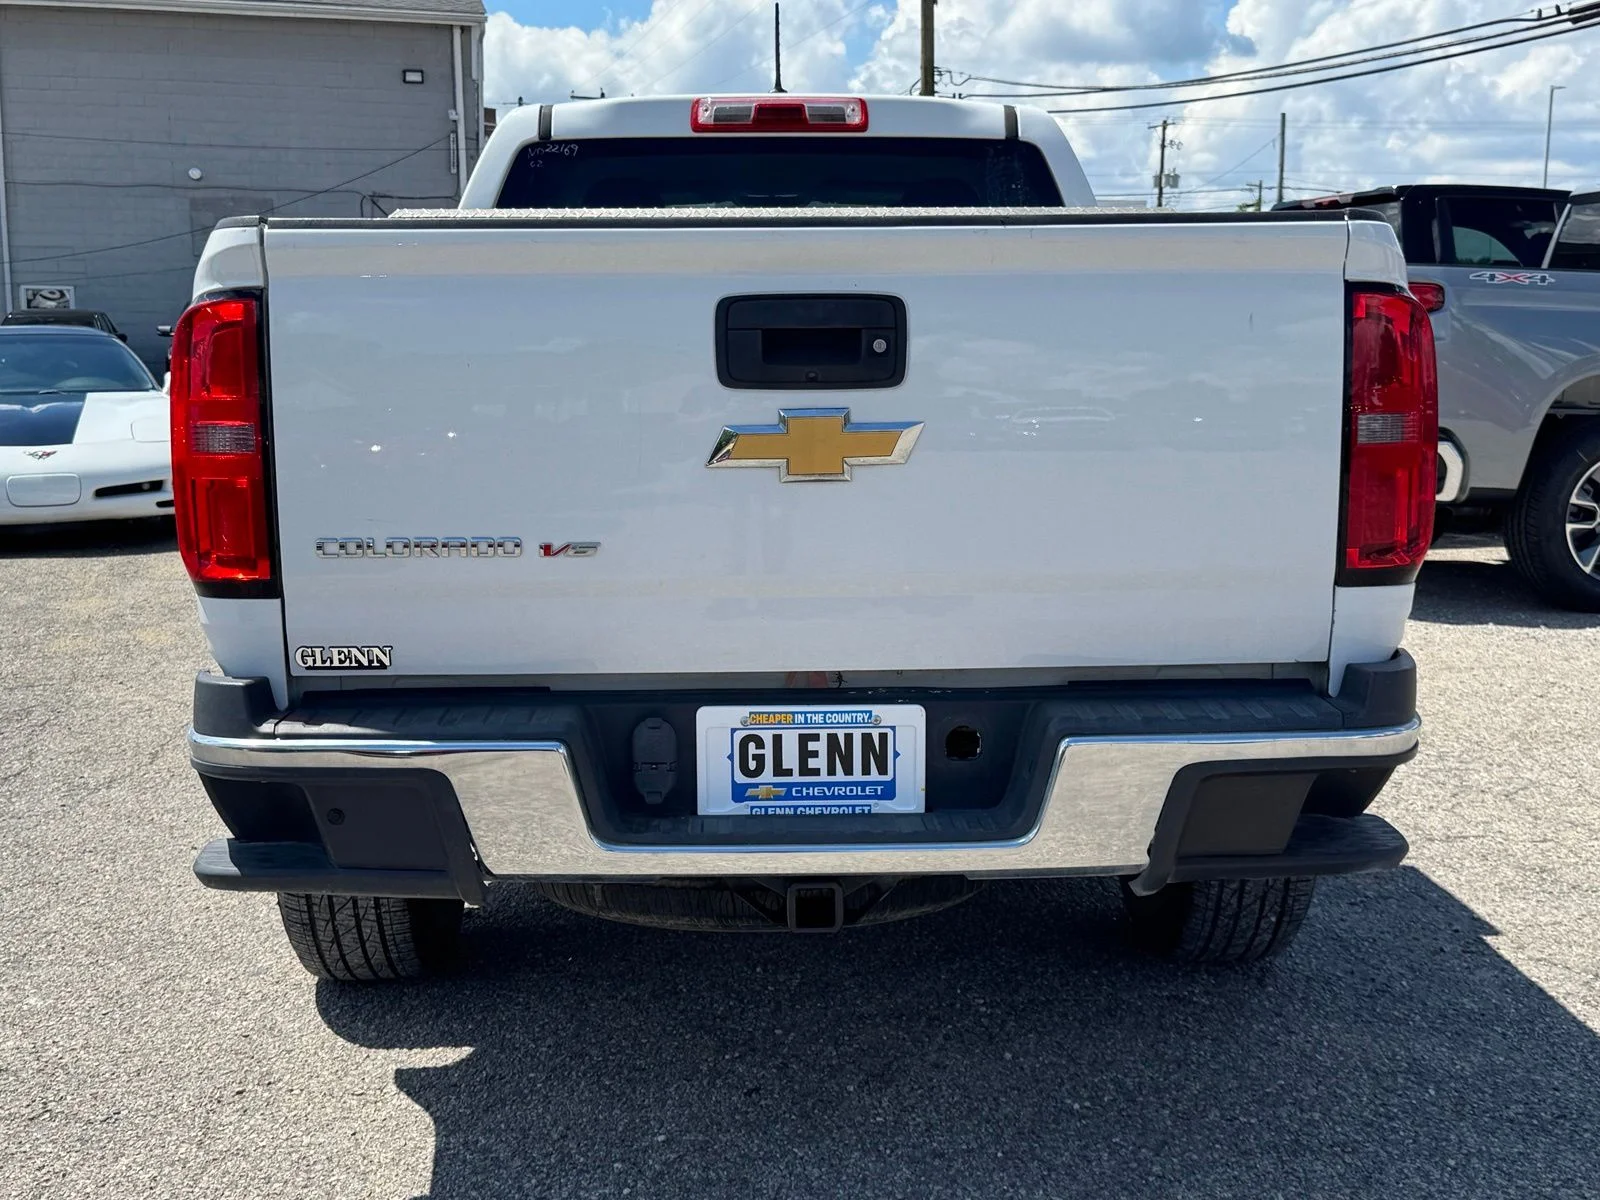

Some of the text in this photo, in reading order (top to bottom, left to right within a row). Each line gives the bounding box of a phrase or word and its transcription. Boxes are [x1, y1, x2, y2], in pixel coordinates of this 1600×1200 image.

[316, 536, 523, 559] COLORADO
[294, 645, 393, 669] GLENN
[749, 712, 872, 725] CHEAPER IN THE COUNTRY.
[738, 732, 889, 779] GLENN
[791, 785, 885, 797] CHEVROLET
